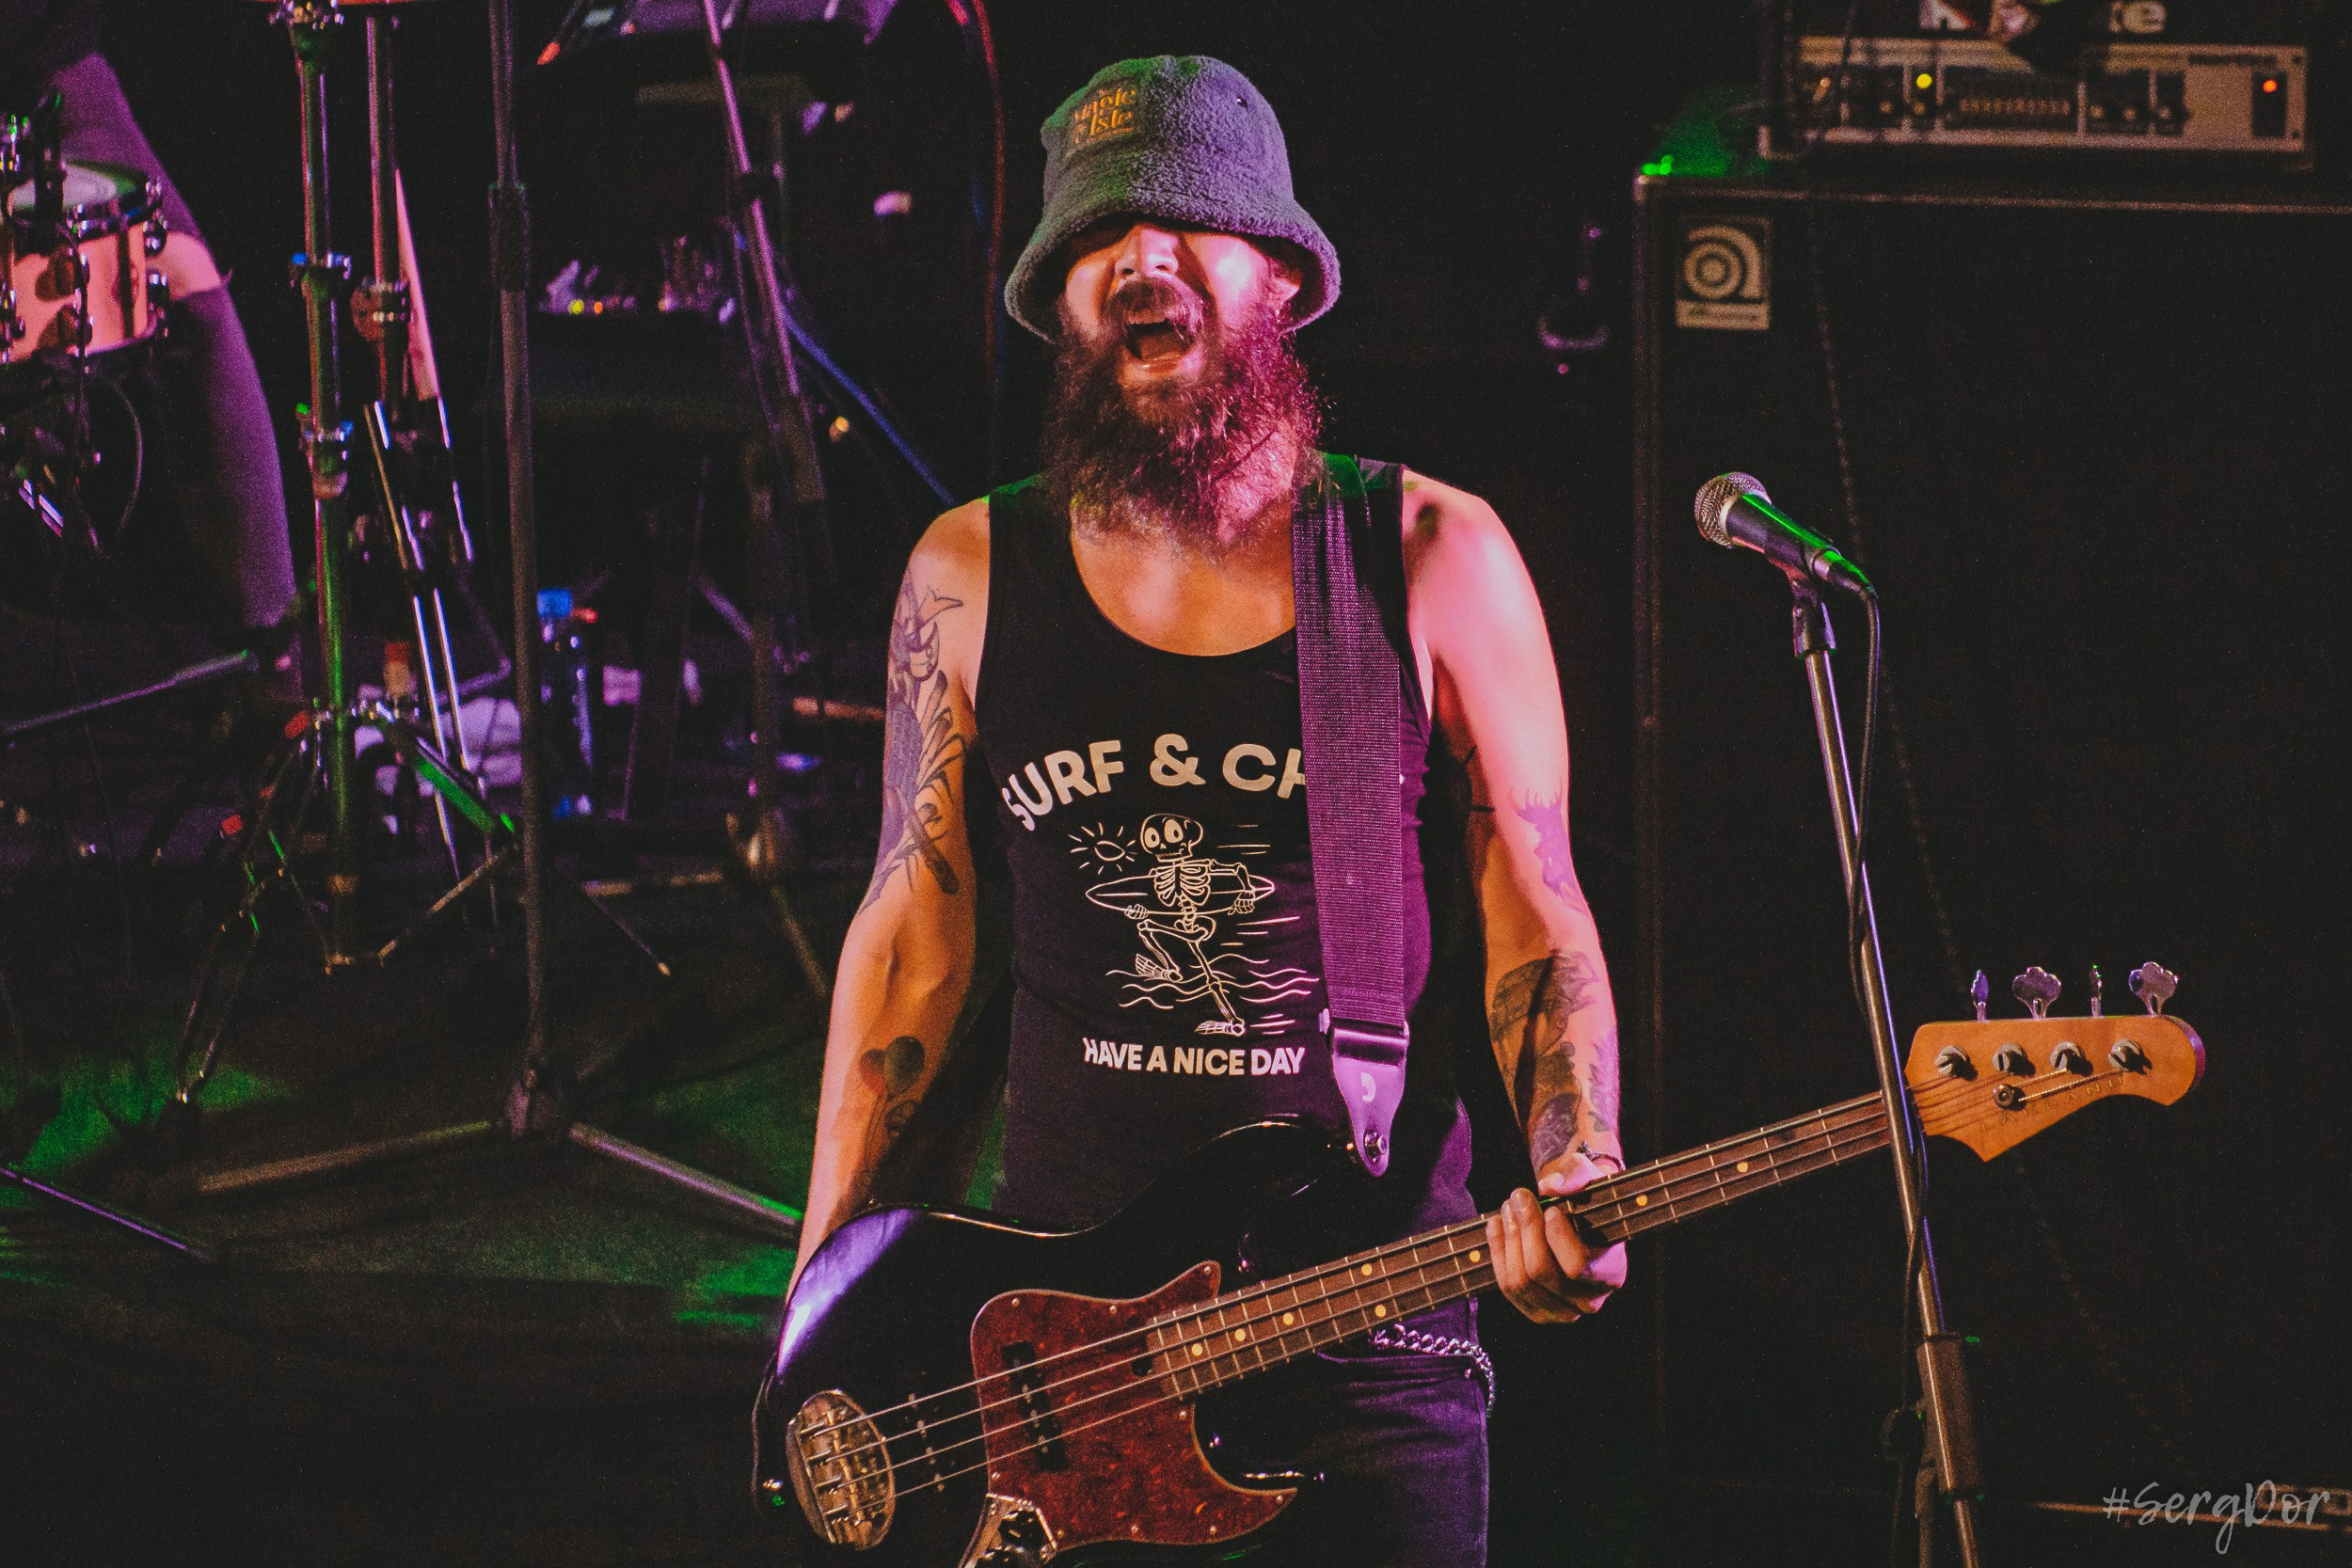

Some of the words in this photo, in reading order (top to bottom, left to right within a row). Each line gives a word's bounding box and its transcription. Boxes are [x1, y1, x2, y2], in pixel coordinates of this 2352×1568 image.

[1002, 739, 1124, 832] SURF
[1150, 733, 1206, 786] &
[1222, 743, 1306, 800] CH
[1082, 1037, 1143, 1070] HAVE
[1145, 1045, 1168, 1073] A
[1173, 1047, 1246, 1076] NICE
[1250, 1047, 1306, 1075] DAY
